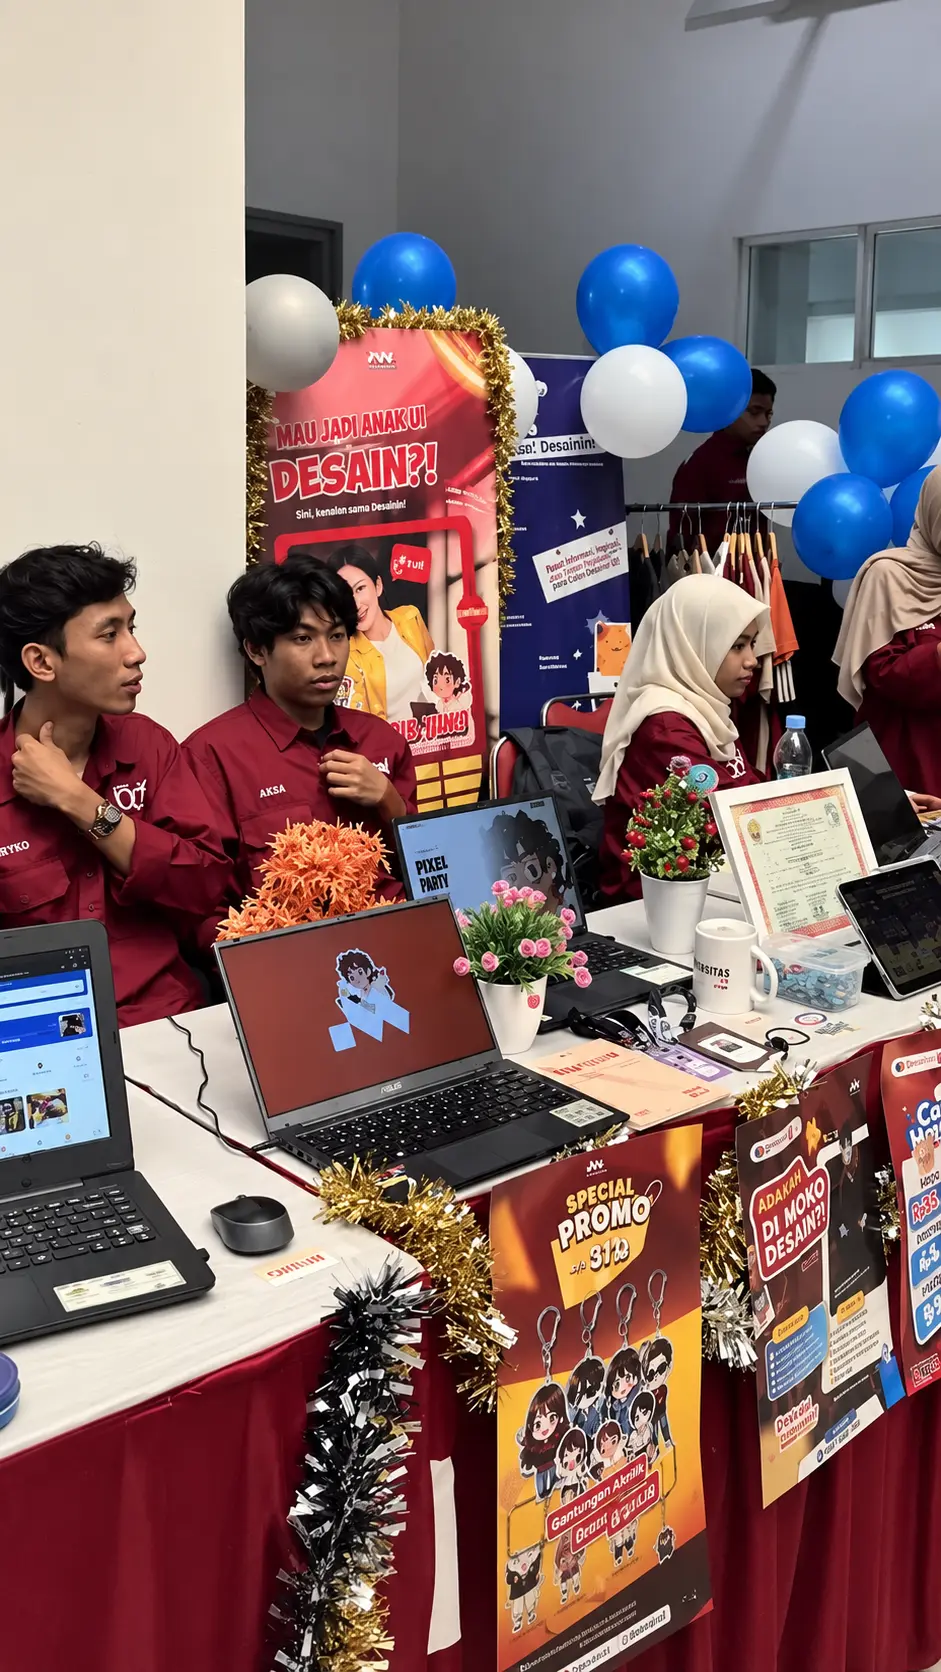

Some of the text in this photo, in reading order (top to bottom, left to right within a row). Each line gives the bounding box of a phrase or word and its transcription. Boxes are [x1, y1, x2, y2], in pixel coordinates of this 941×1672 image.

[275, 404, 427, 450] MAU JADI ANAK UI
[541, 436, 596, 453] Desainin!
[269, 442, 438, 503] DESAIN?!
[296, 508, 315, 520] Sini,
[259, 784, 287, 799] AKSA
[0, 840, 30, 858] RYKO
[415, 855, 449, 876] PIXEL
[419, 873, 449, 893] PARTY
[566, 1177, 634, 1214] SPECIAL
[758, 1168, 802, 1214] ADAKAH
[762, 1176, 825, 1243] DI MOKO
[557, 1195, 650, 1250] PROMO
[765, 1201, 826, 1268] DESAIN?!
[551, 1485, 611, 1531] Gantungan
